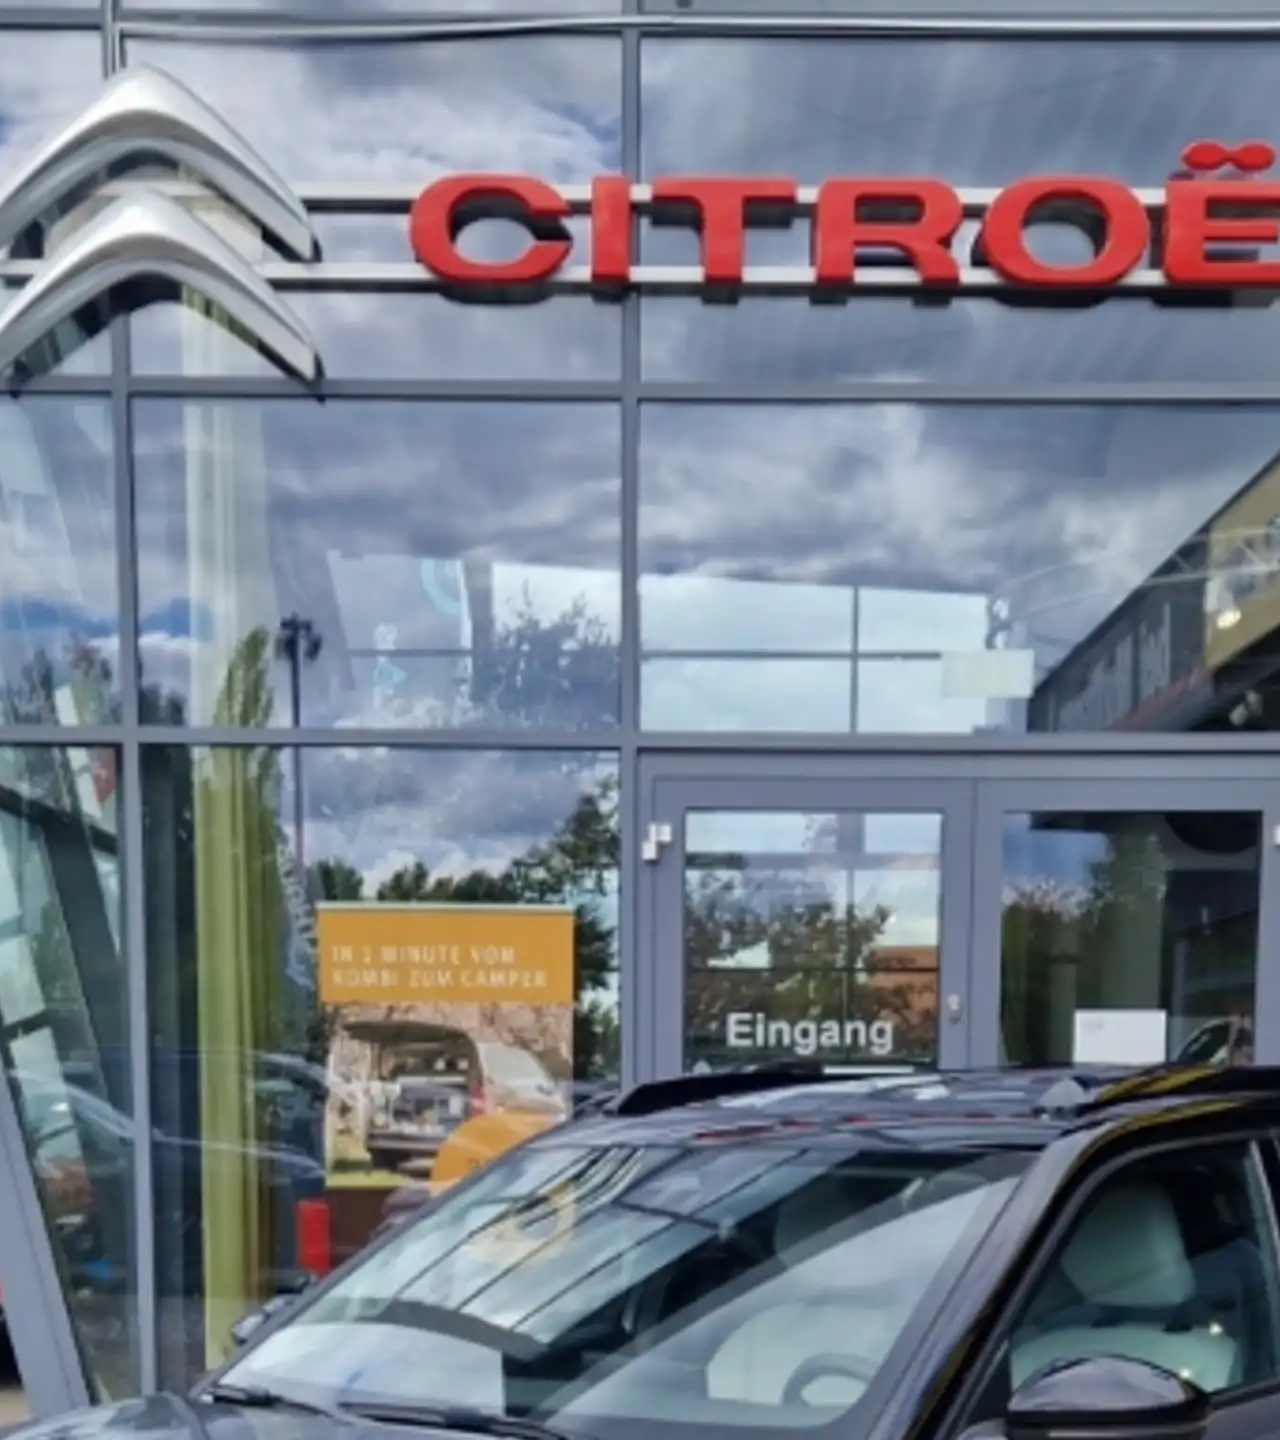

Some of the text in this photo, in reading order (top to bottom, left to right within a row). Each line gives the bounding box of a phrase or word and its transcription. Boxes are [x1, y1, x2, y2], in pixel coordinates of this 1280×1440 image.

[380, 944, 462, 966] MINUTE
[409, 968, 455, 989] ZUM
[460, 968, 549, 989] CAMPER
[726, 1011, 893, 1056] Eingang
